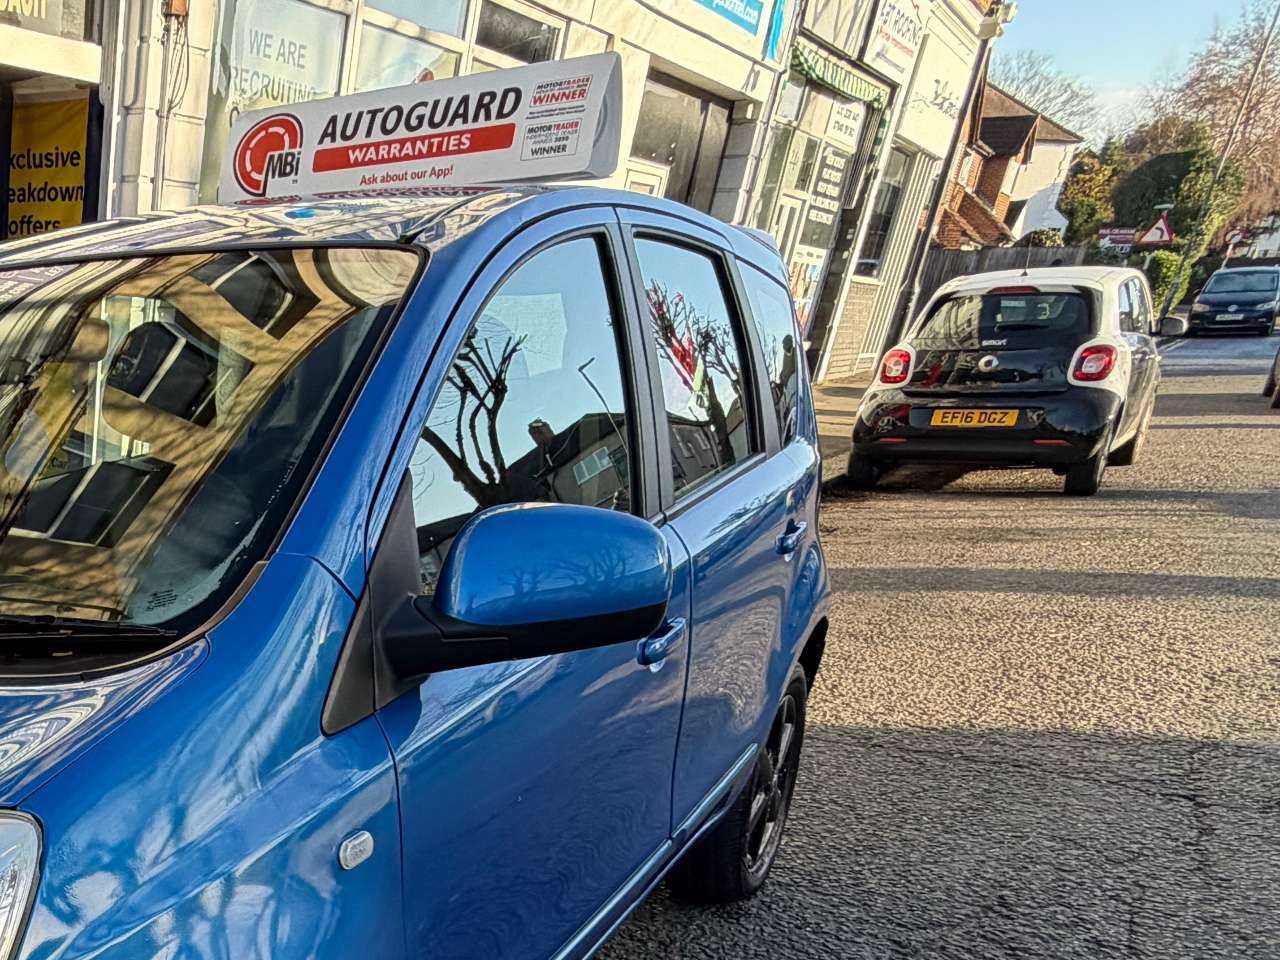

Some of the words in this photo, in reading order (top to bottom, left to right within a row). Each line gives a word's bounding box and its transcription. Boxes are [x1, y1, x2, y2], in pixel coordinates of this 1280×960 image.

[249, 29, 273, 59] WE
[276, 38, 307, 69] ARE
[533, 89, 587, 105] WINNER
[317, 86, 523, 146] AUTOGUARD
[10, 147, 81, 169] xclusive
[348, 133, 472, 164] WARRANTIES
[531, 144, 568, 156] WINNER
[269, 149, 302, 180] MBi
[360, 174, 378, 186] Ask
[380, 169, 409, 184] about
[410, 170, 427, 181] our
[428, 164, 454, 180] App!
[940, 411, 976, 424] EF16
[977, 411, 1009, 424] DGZ
